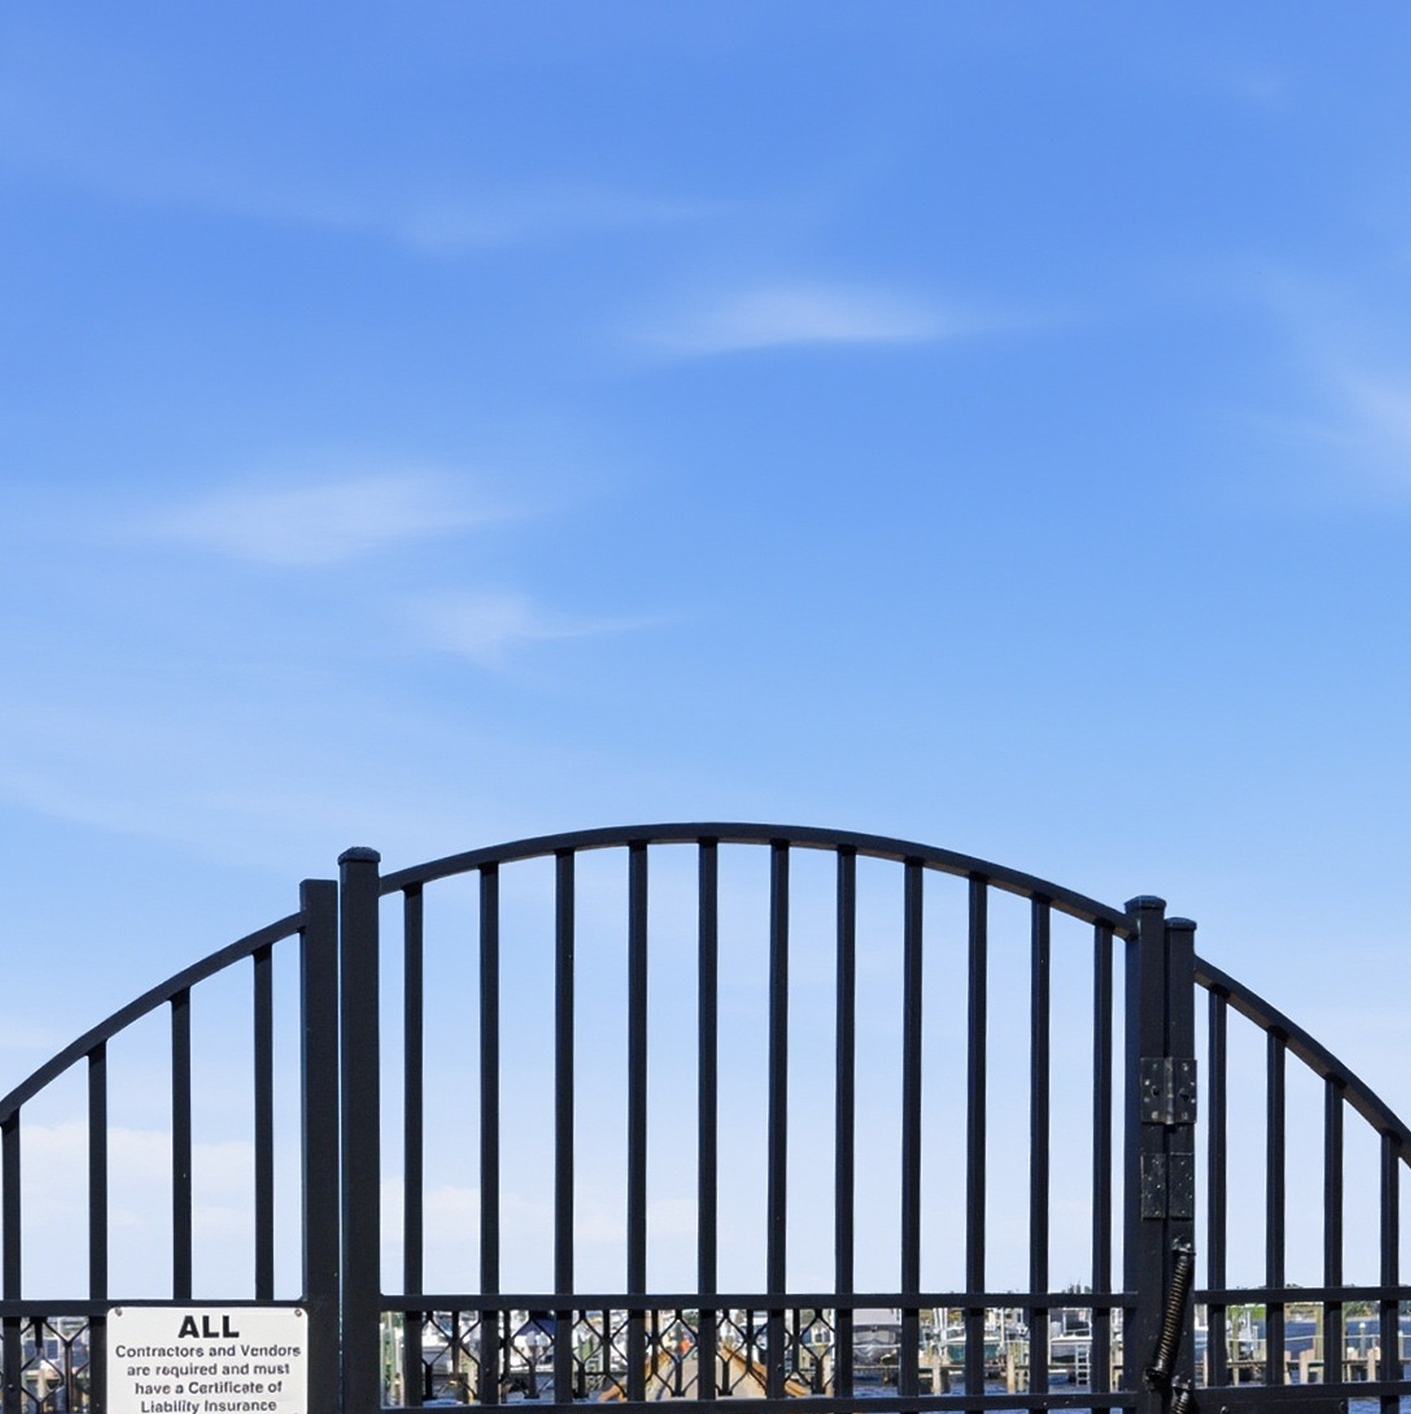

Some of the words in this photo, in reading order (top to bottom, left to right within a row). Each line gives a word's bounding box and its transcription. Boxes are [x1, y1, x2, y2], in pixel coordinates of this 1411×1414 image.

[178, 1315, 240, 1338] ALL
[115, 1345, 204, 1358] Contractors
[209, 1345, 236, 1357] and
[240, 1344, 301, 1357] Vendors
[127, 1365, 150, 1376] are
[155, 1363, 217, 1378] required
[222, 1363, 249, 1375] and
[253, 1363, 290, 1375] must
[135, 1383, 171, 1395] have
[175, 1384, 184, 1394] a
[188, 1381, 264, 1394] Certificate
[267, 1381, 283, 1393] of
[141, 1400, 200, 1414] Liability
[204, 1400, 277, 1412] Insurance
